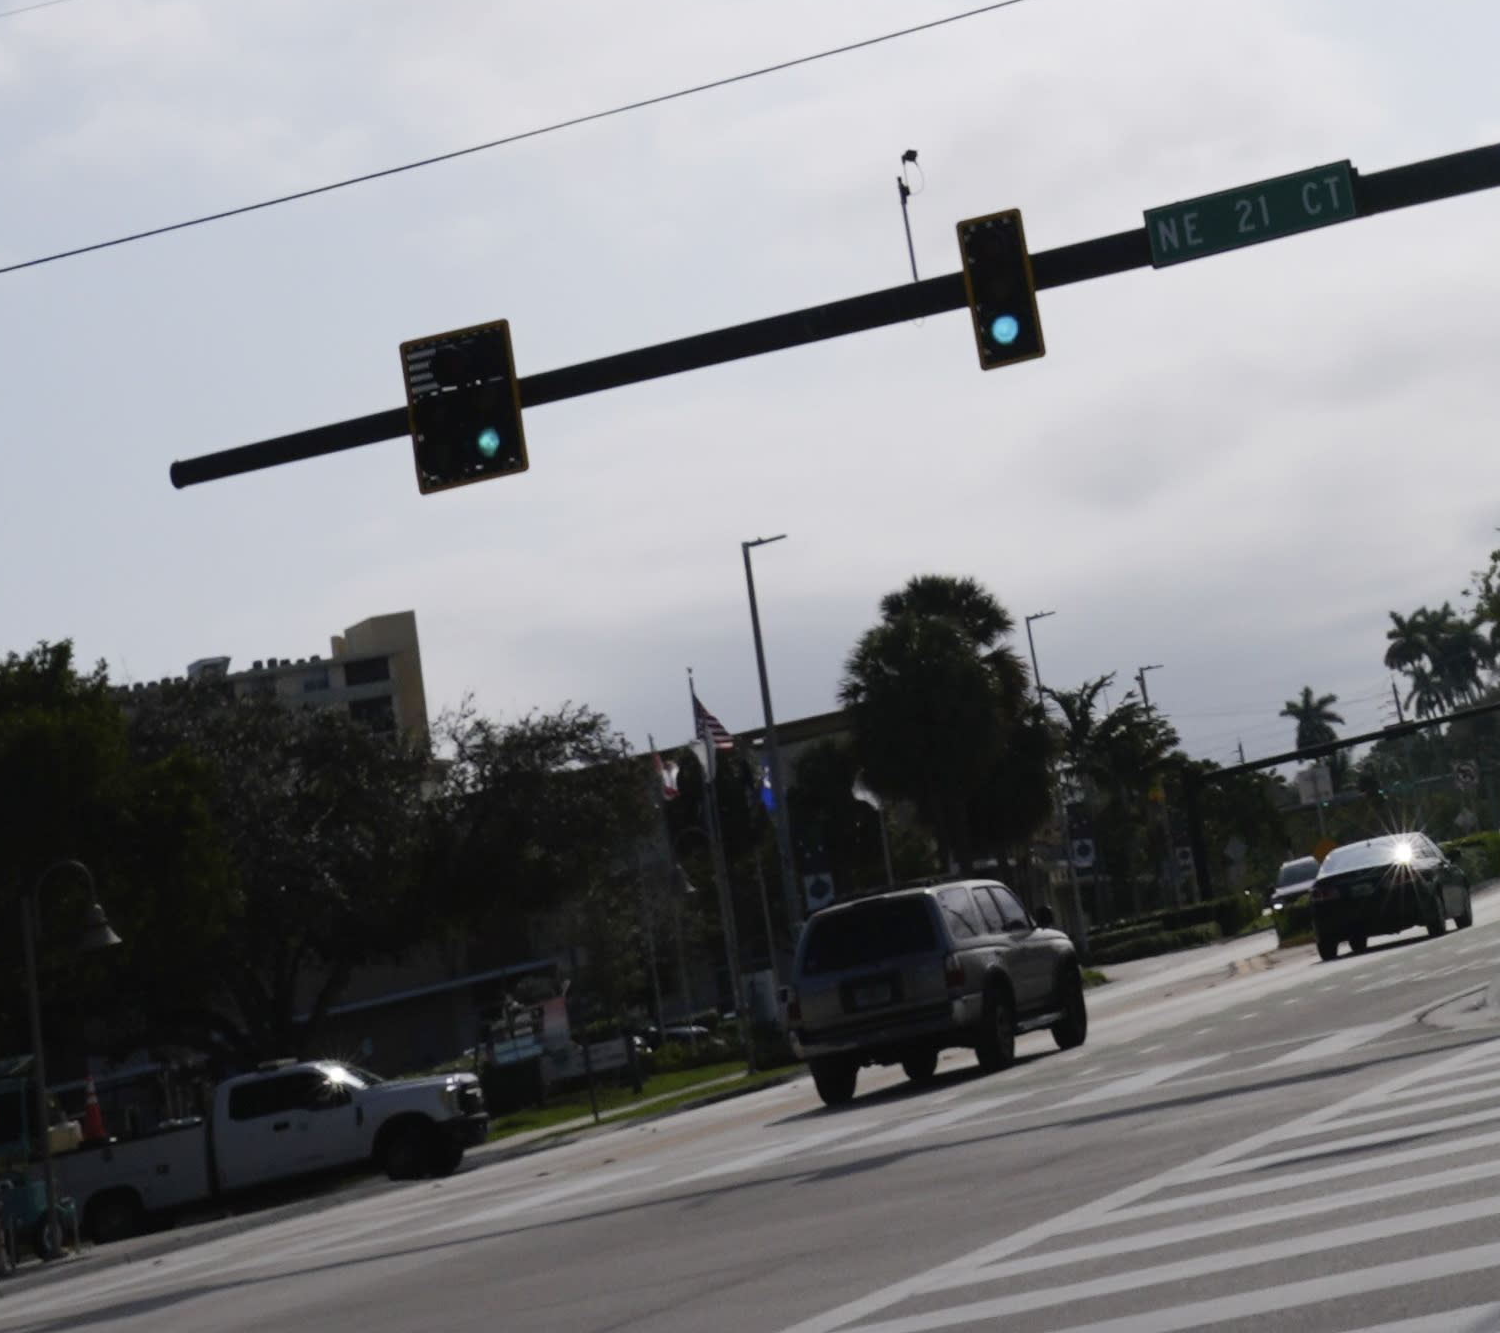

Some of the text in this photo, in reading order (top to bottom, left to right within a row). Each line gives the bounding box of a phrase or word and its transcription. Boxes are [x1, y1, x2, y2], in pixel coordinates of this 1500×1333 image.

[1156, 176, 1340, 253] NE 21 CT
